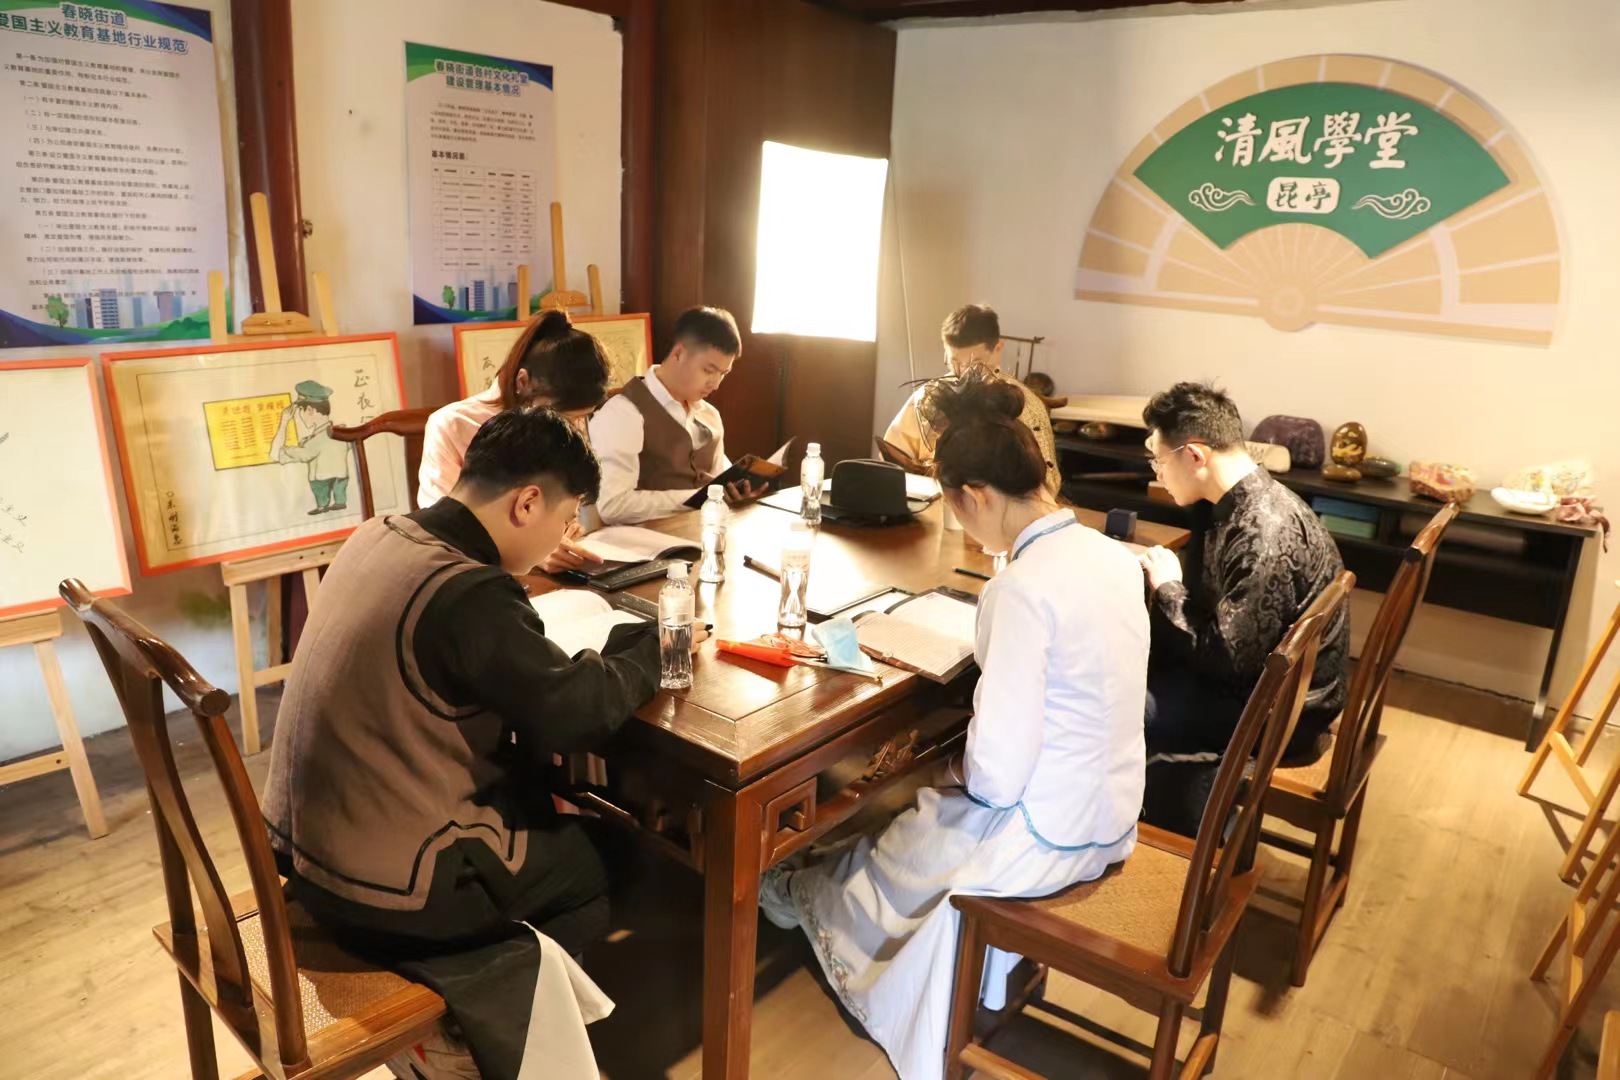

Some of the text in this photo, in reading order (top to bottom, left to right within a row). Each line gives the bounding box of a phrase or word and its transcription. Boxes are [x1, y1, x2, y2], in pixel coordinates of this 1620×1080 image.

[0, 13, 187, 53] 爱国主义教育基地行业规范
[61, 4, 125, 25] 春晓街道
[1214, 111, 1420, 171] 清風學堂
[1274, 180, 1332, 212] 昆亭
[353, 369, 375, 425] 正衣
